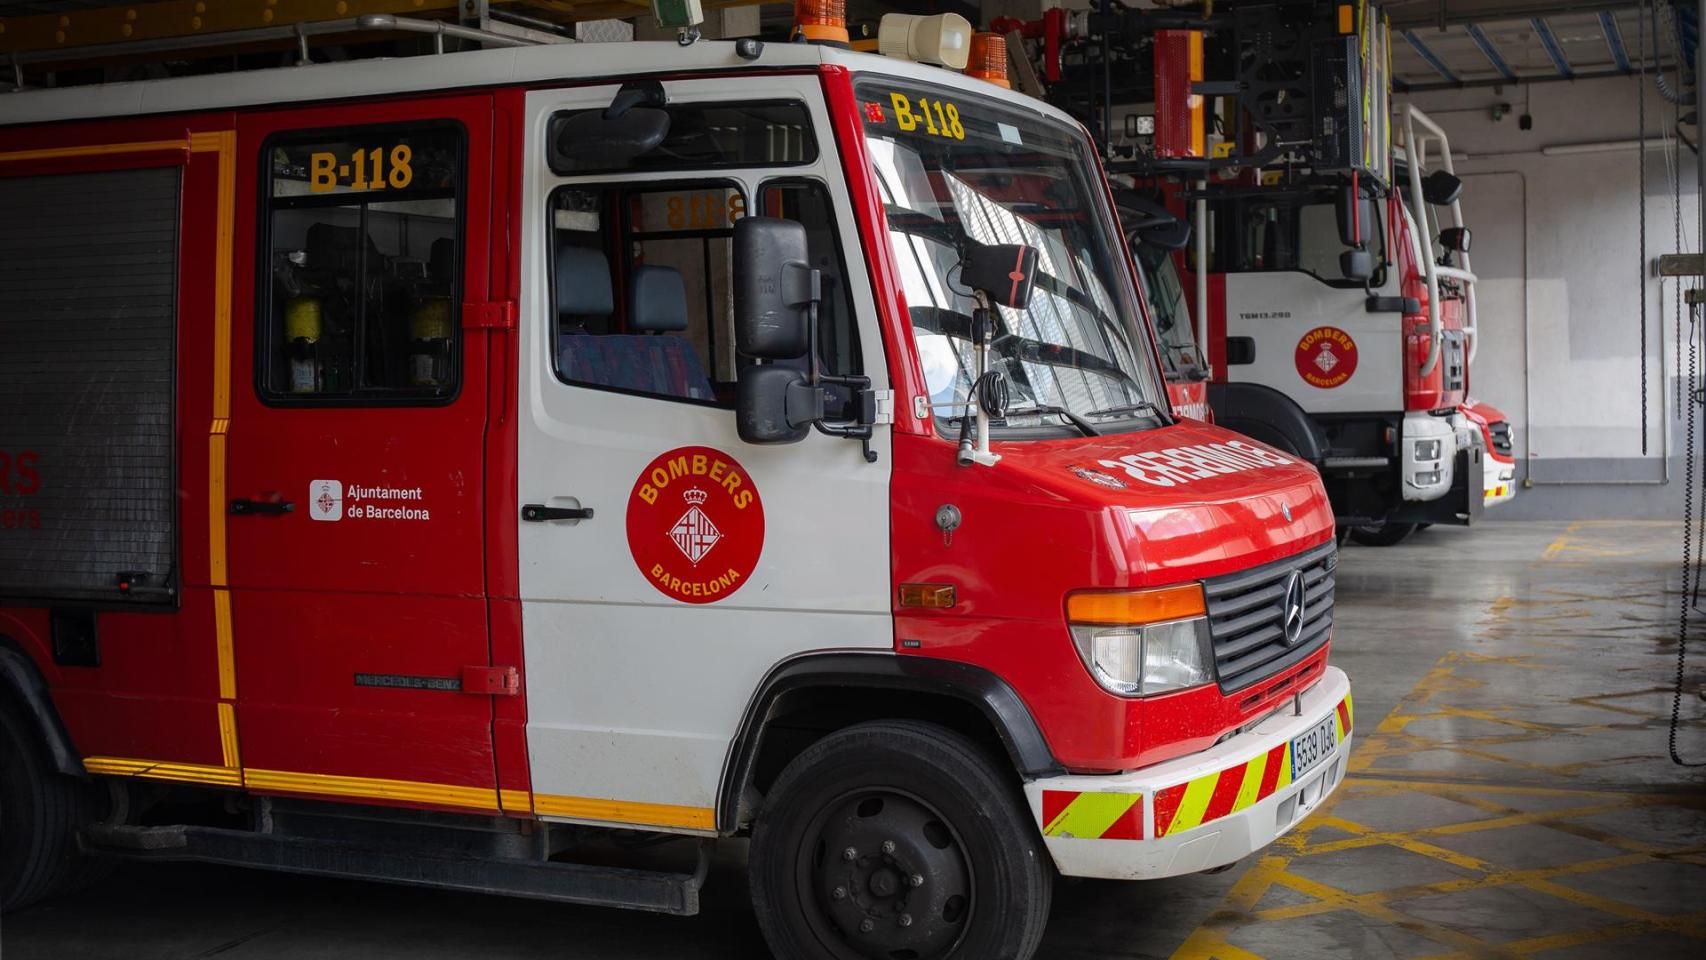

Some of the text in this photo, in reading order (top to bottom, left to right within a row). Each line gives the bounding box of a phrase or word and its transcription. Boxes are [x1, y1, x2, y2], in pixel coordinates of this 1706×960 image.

[890, 92, 965, 140] B-118
[310, 144, 414, 192] B-118
[1300, 328, 1354, 351] BOMBERS
[1305, 373, 1348, 386] BARCELONA
[347, 484, 422, 502] Ajuntament
[638, 454, 754, 510] BOMBERS
[347, 504, 430, 521] de Barcelona
[651, 563, 741, 596] BARCELONA
[1296, 731, 1318, 772] 5539
